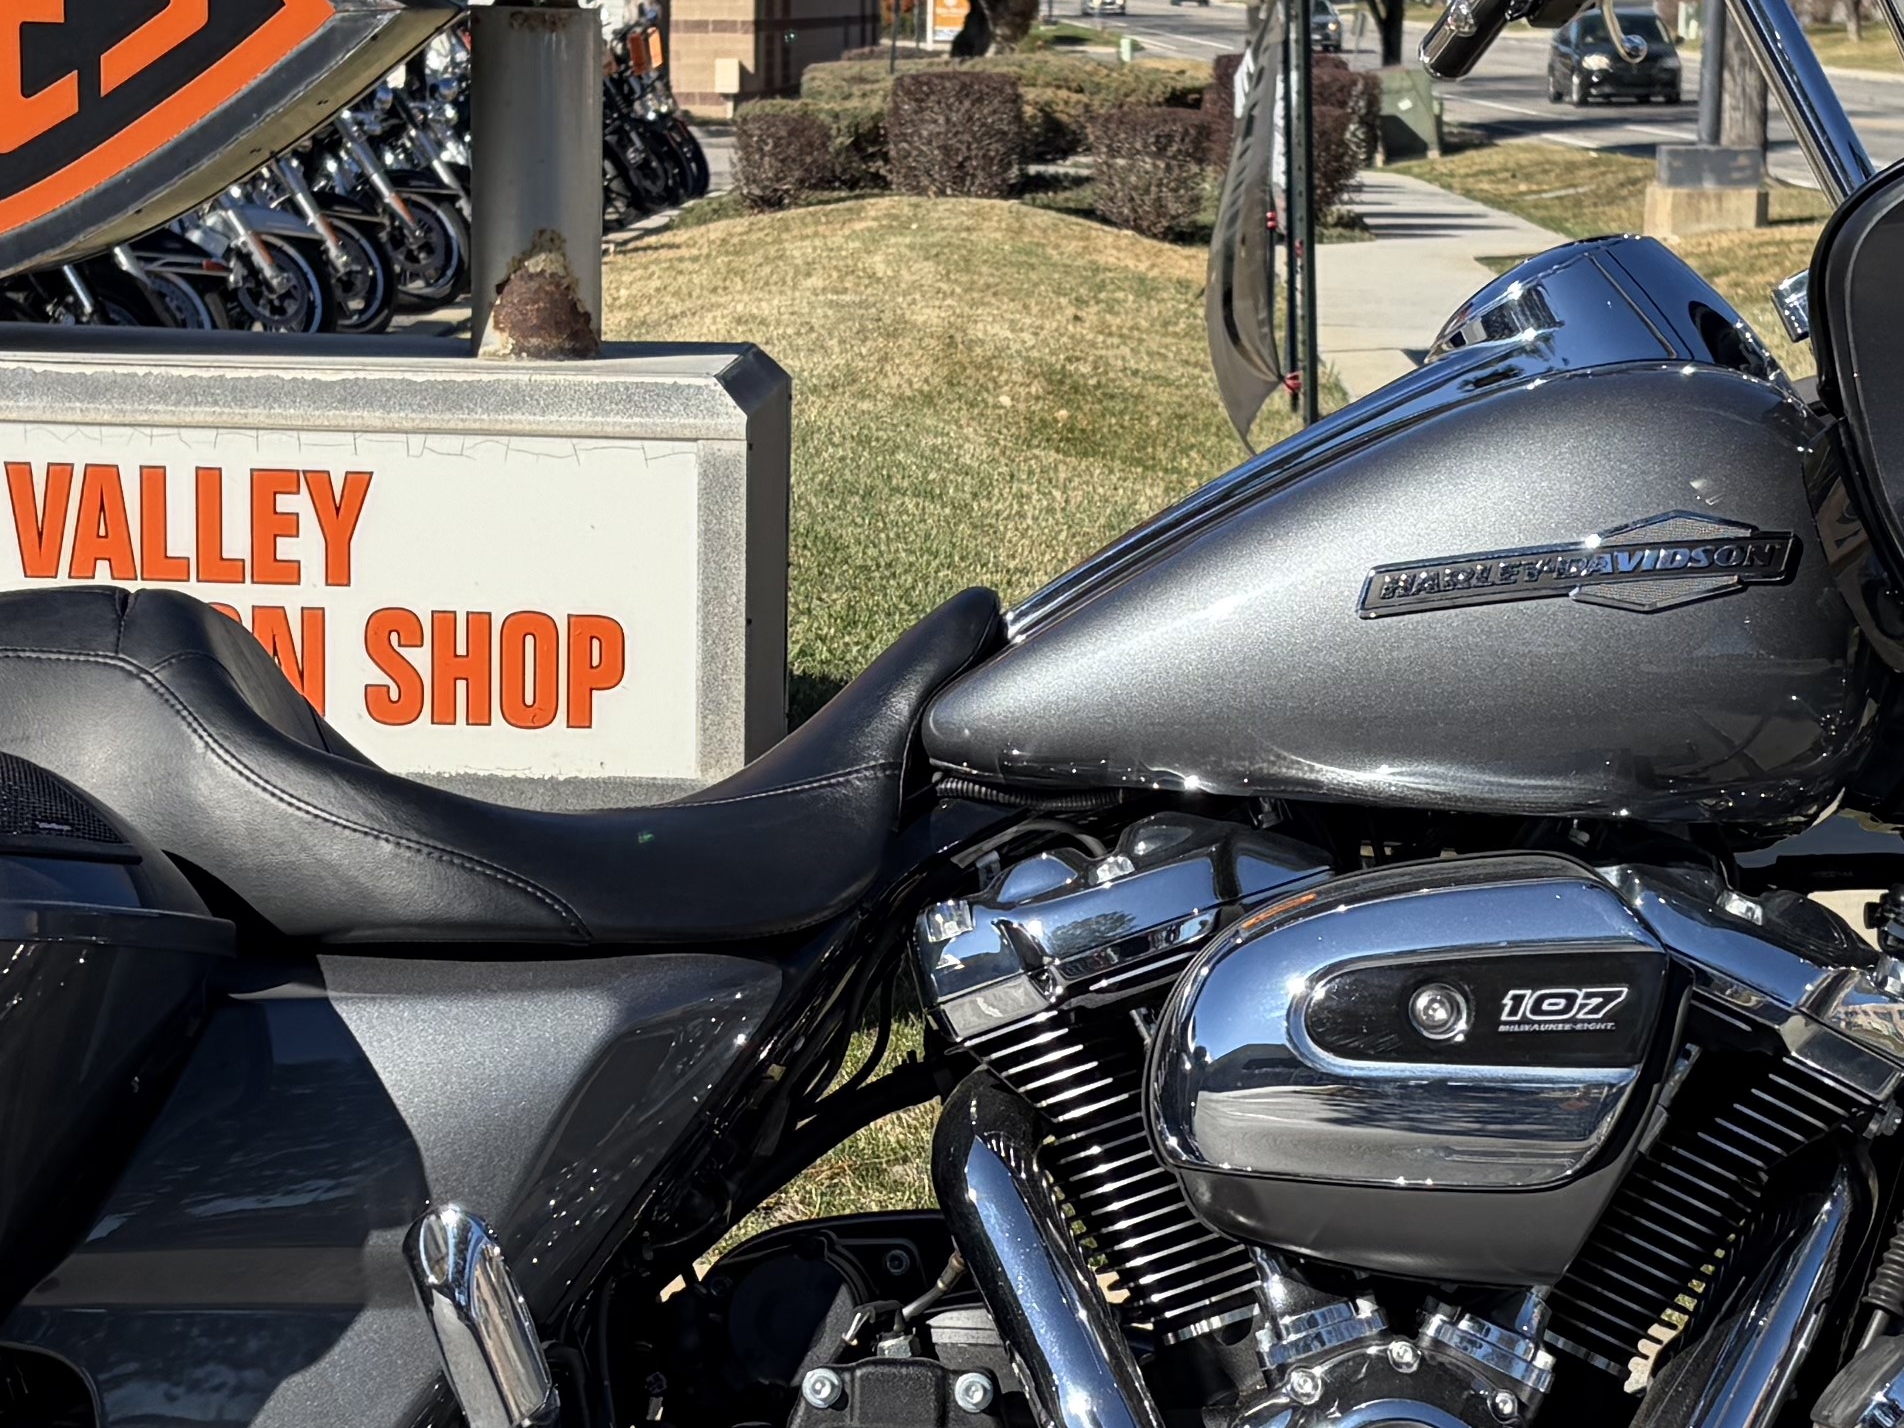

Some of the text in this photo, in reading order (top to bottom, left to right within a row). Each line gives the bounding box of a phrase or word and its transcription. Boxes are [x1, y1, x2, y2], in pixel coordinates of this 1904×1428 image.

[3, 460, 375, 588] VALLEY
[1378, 543, 1783, 600] HARLEY-DAVIDSON
[363, 606, 626, 730] SHOP
[1500, 986, 1629, 1021] 107
